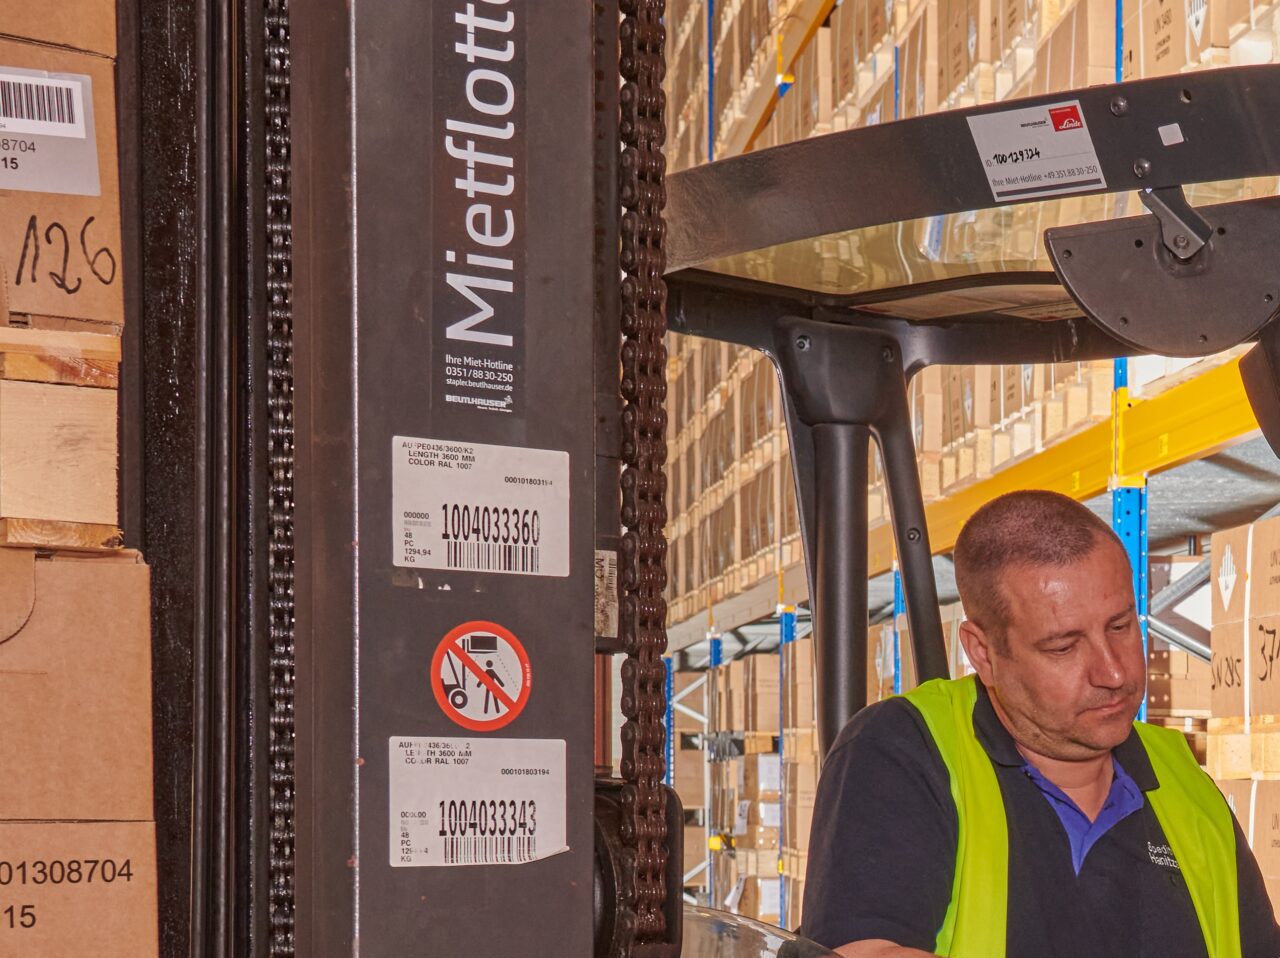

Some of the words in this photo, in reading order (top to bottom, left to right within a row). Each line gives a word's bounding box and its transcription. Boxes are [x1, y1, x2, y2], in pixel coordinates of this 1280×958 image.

[0, 138, 36, 152] 8704
[1, 157, 19, 170] 15
[446, 0, 515, 347] Mietflott
[16, 214, 116, 294] 126
[445, 354, 462, 365] Ihre
[463, 356, 513, 371] Miet-Hotline
[408, 450, 439, 459] LENGTH
[408, 458, 435, 467] COLOR
[442, 503, 541, 546] 1004033360
[501, 768, 550, 776] 000101803194
[439, 800, 536, 836] 1004033343
[401, 839, 411, 847] PC
[4, 905, 36, 928] 15
